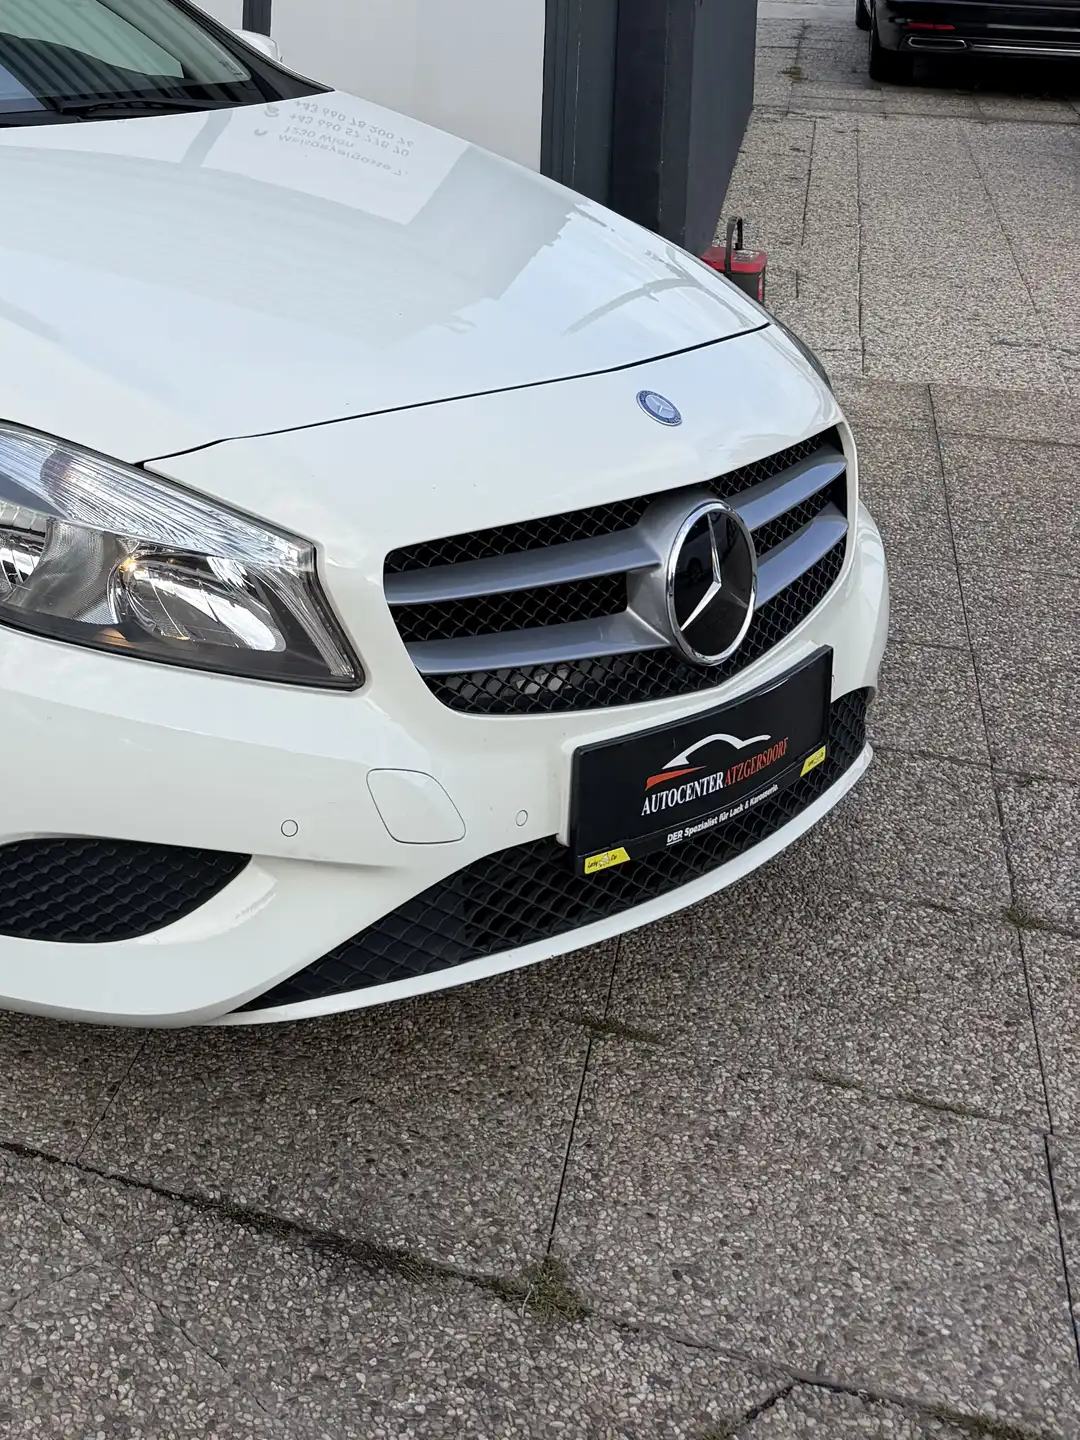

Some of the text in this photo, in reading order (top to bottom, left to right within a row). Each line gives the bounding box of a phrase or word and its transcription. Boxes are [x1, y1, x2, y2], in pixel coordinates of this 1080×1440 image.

[641, 737, 789, 816] AUTOCENTER ATZGERSDORF
[667, 830, 683, 844] DER
[684, 817, 718, 837] Spezialist
[719, 812, 729, 823] für
[729, 804, 744, 818] Lack
